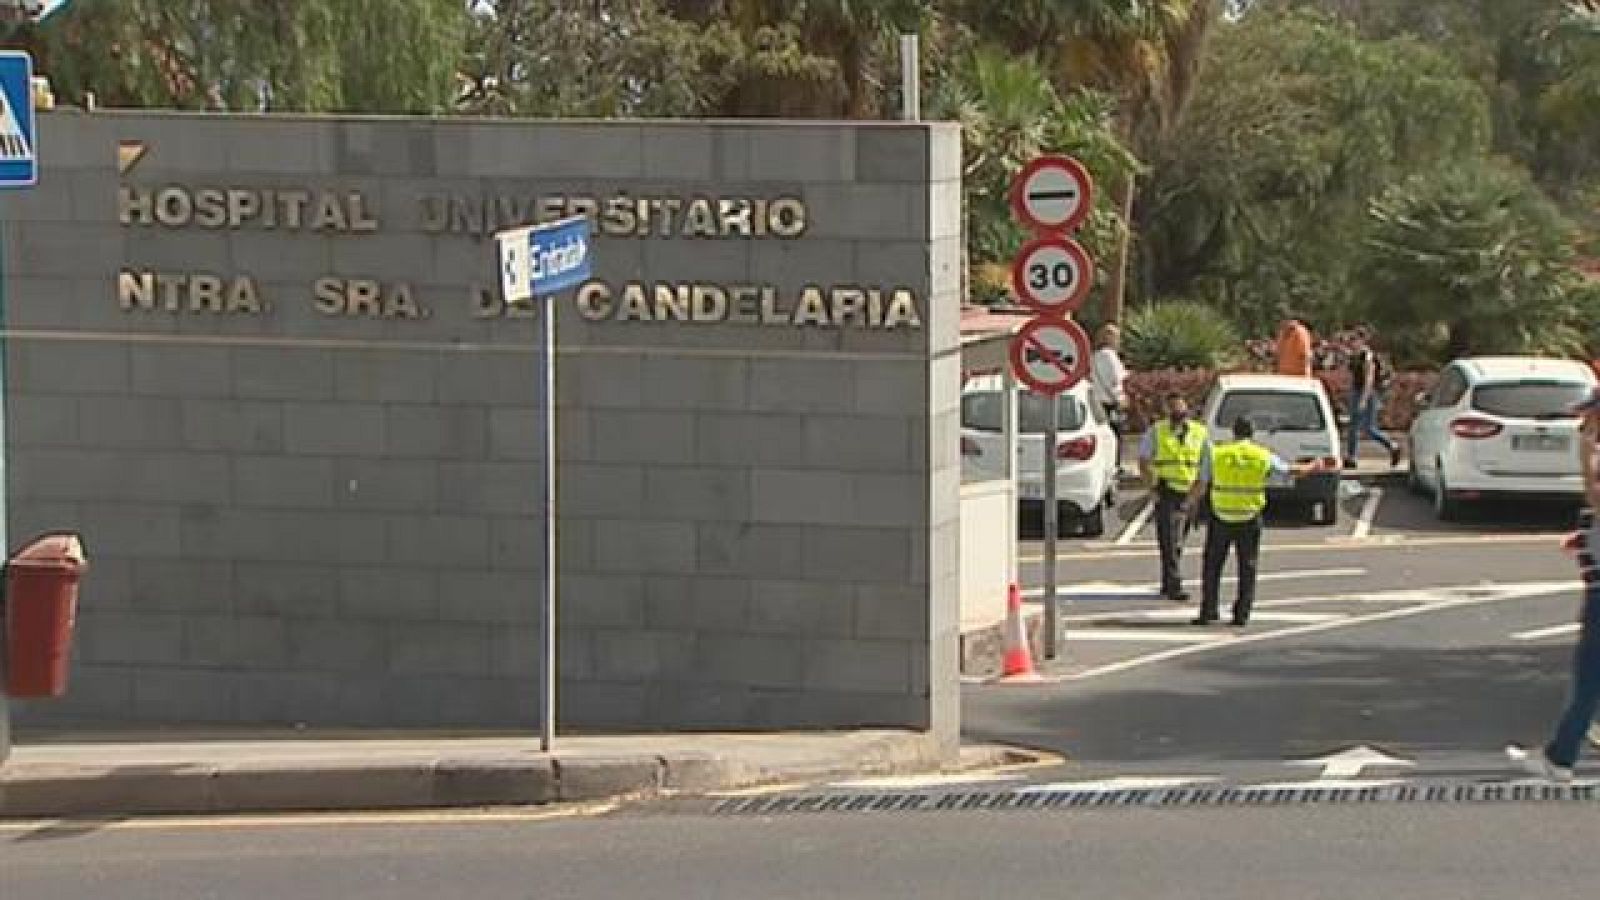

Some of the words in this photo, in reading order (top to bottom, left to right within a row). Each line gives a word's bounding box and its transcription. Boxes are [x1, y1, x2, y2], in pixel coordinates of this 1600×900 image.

[119, 186, 379, 231] HOSPITAL
[418, 194, 807, 237] UNIVERSITARIO
[119, 270, 273, 313] NTRA.
[315, 279, 432, 318] SRA.
[577, 284, 922, 328] CANDELARIA
[1029, 263, 1074, 289] 30
